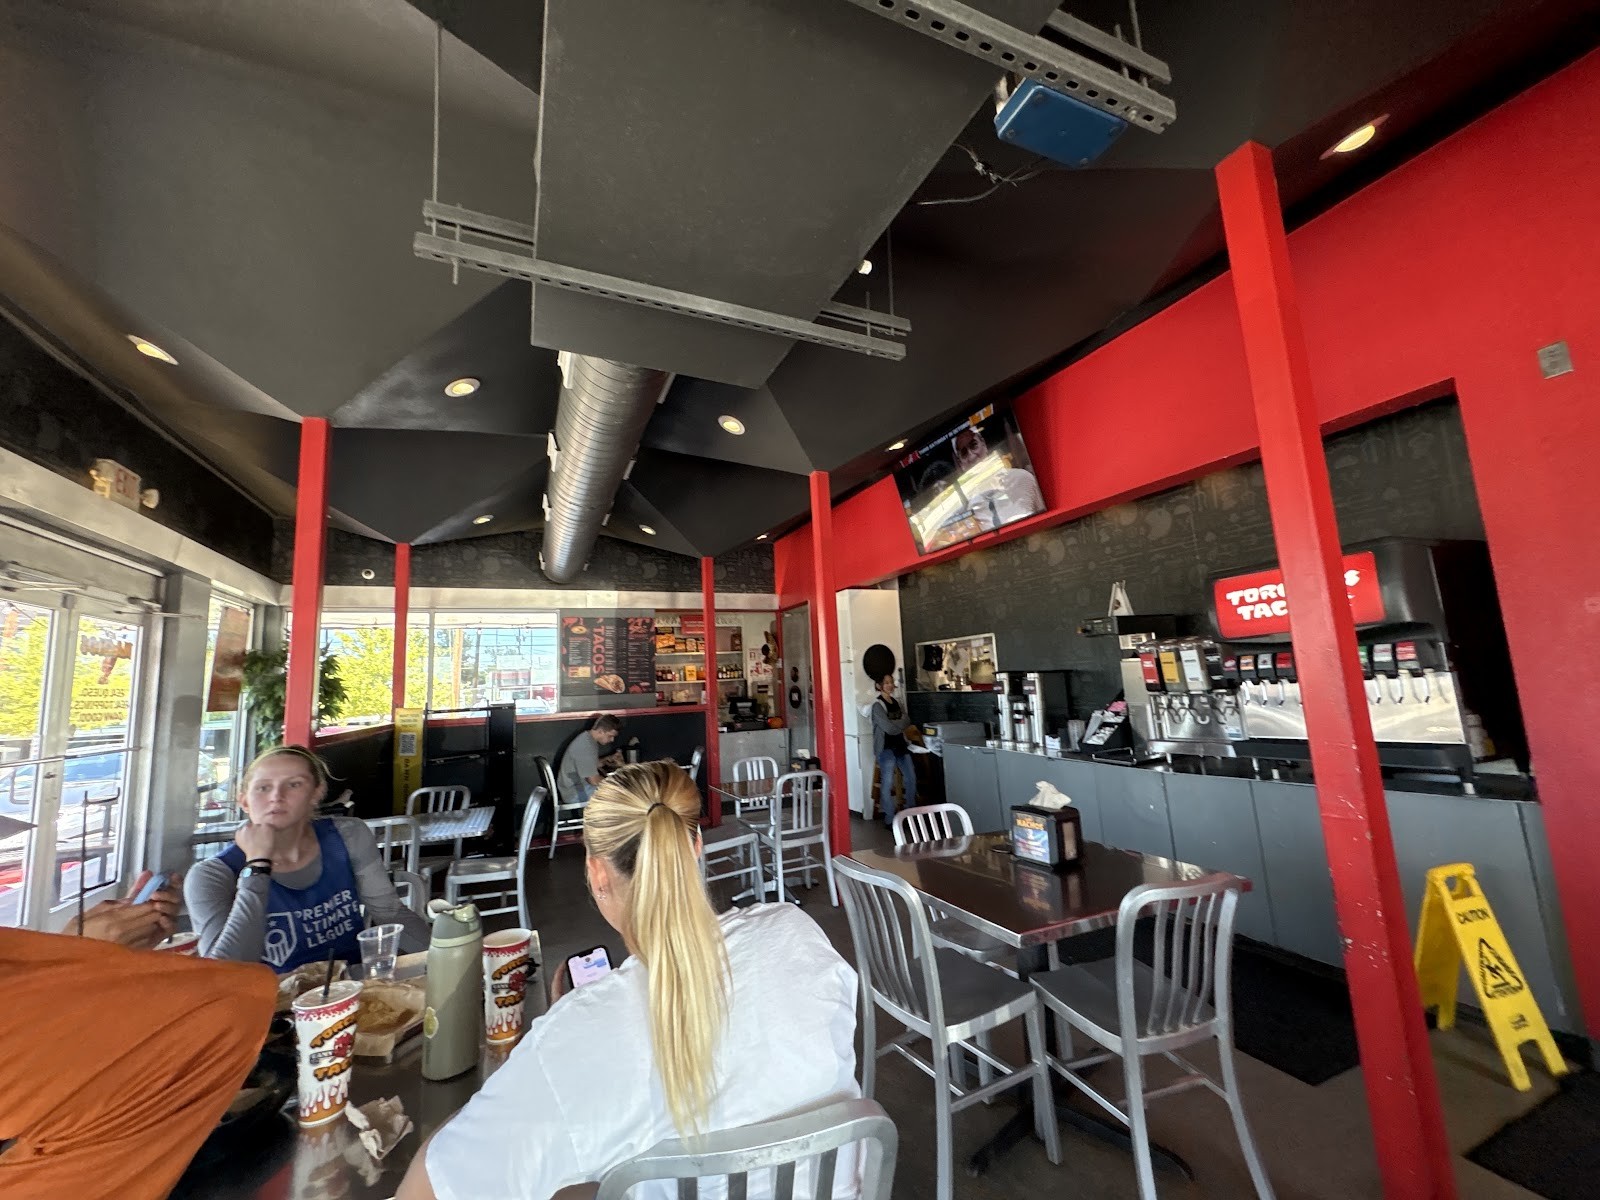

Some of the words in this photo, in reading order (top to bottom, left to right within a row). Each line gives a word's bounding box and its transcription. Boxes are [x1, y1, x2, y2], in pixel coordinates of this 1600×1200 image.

[592, 626, 605, 674] TACOS
[302, 900, 359, 934] LTIMATE
[306, 918, 354, 949] LEGUE
